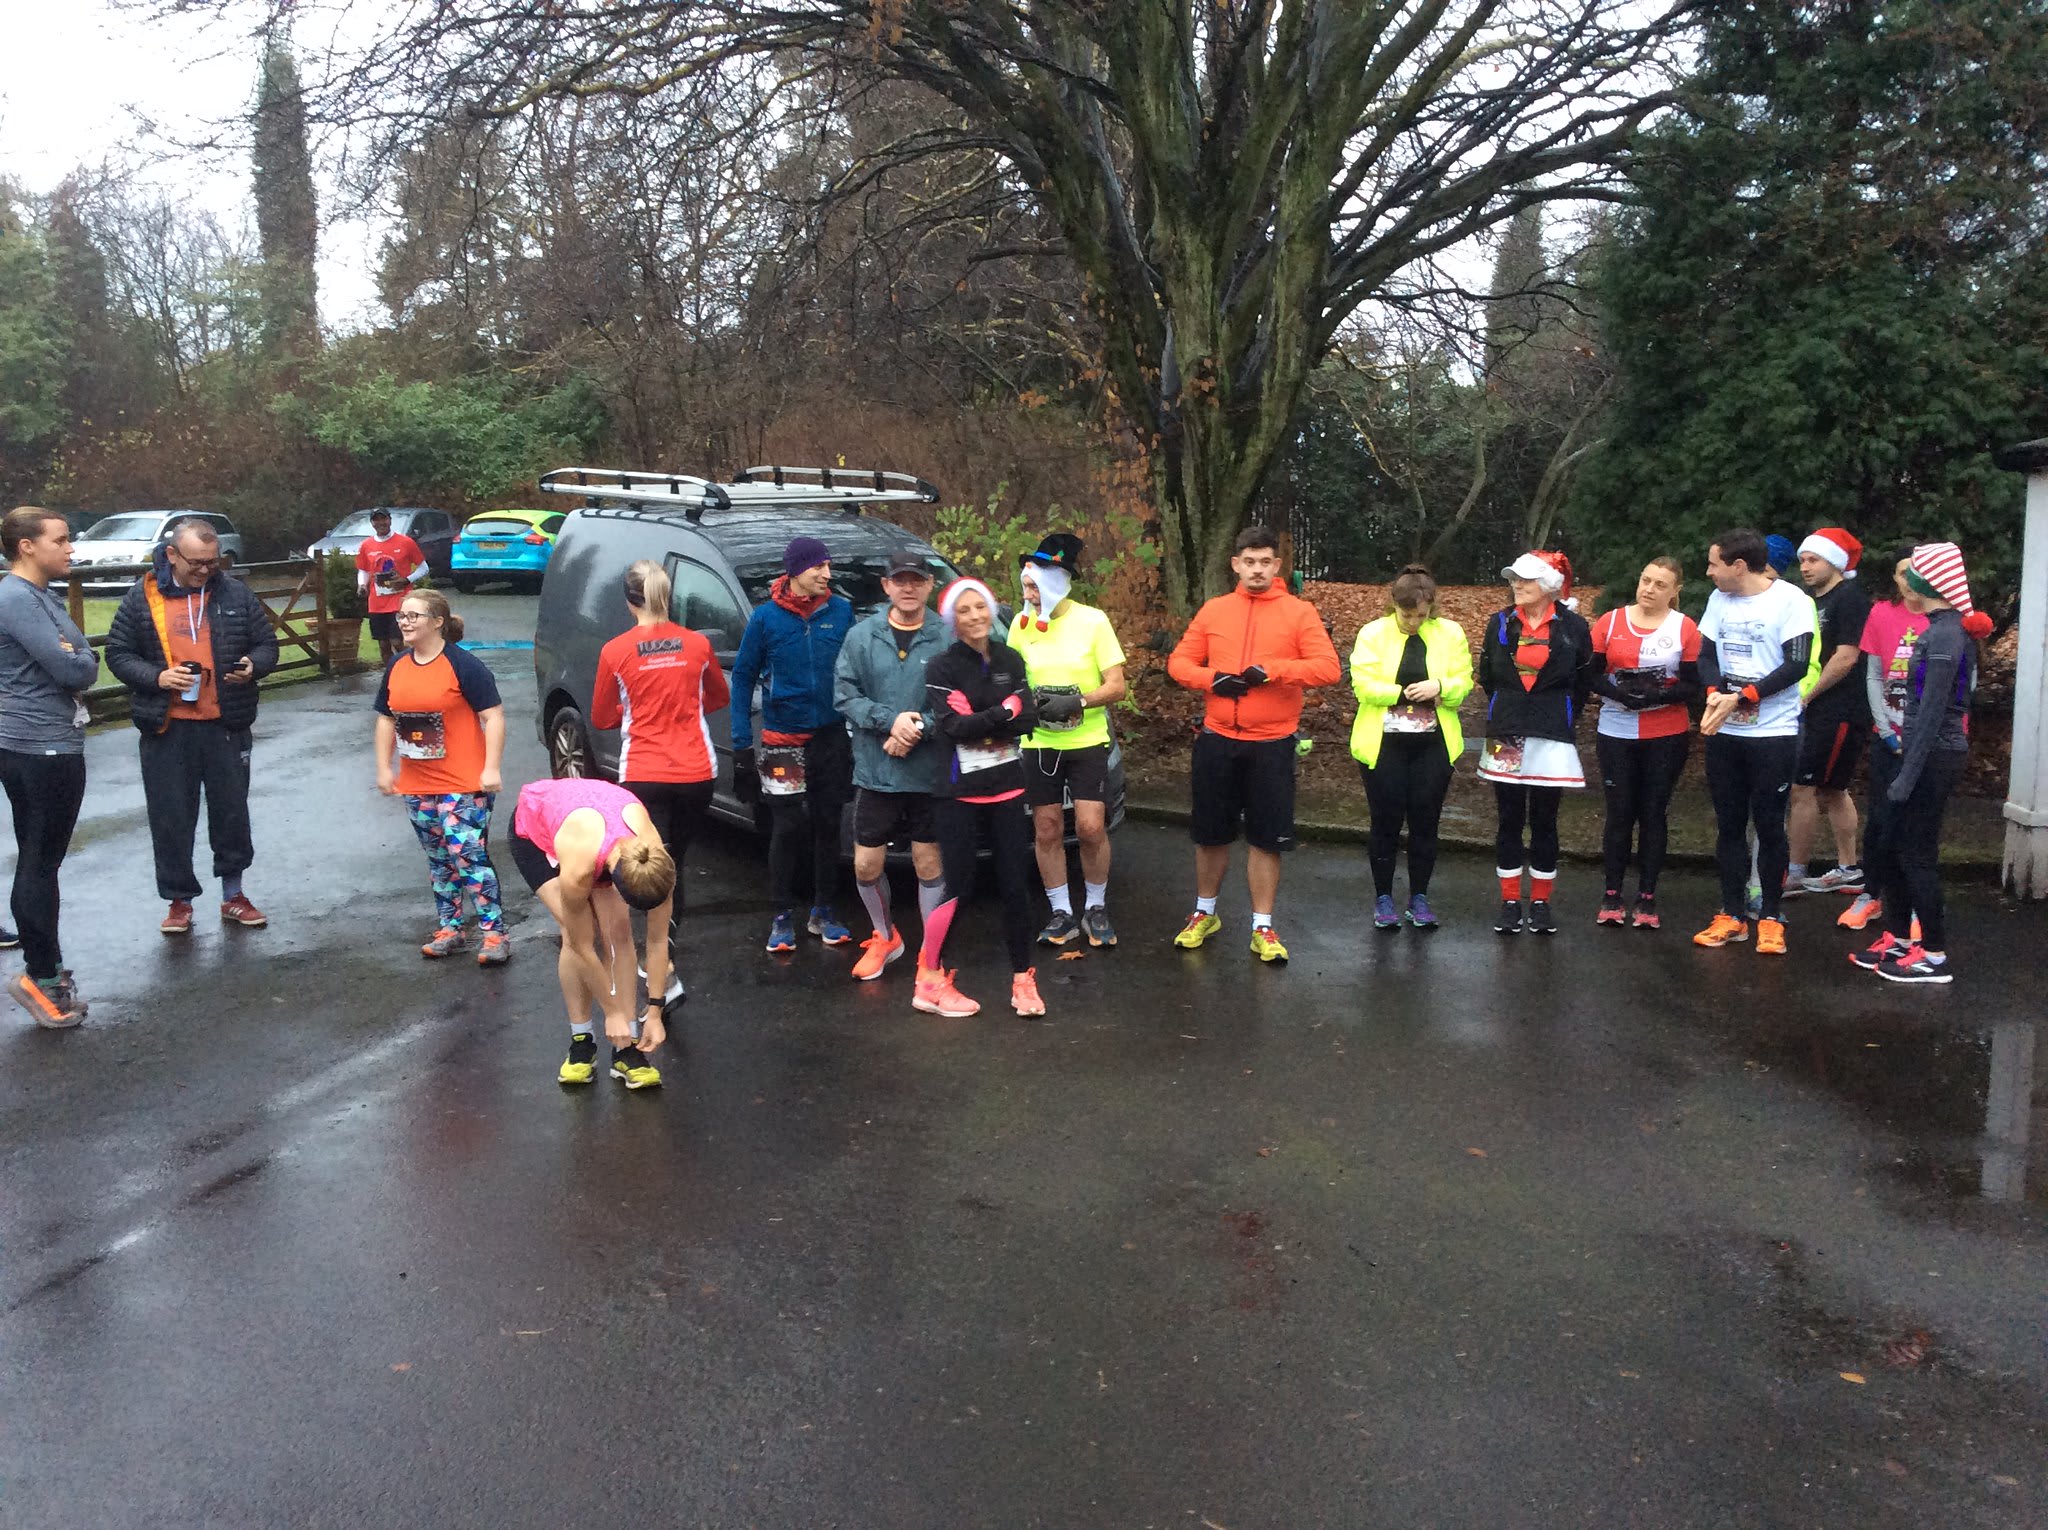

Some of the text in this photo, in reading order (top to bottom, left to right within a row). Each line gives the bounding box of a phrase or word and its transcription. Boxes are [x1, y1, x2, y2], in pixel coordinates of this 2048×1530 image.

[638, 637, 682, 652] TUDOR
[1406, 705, 1414, 714] 2
[412, 731, 423, 740] 52
[1495, 744, 1502, 753] 7
